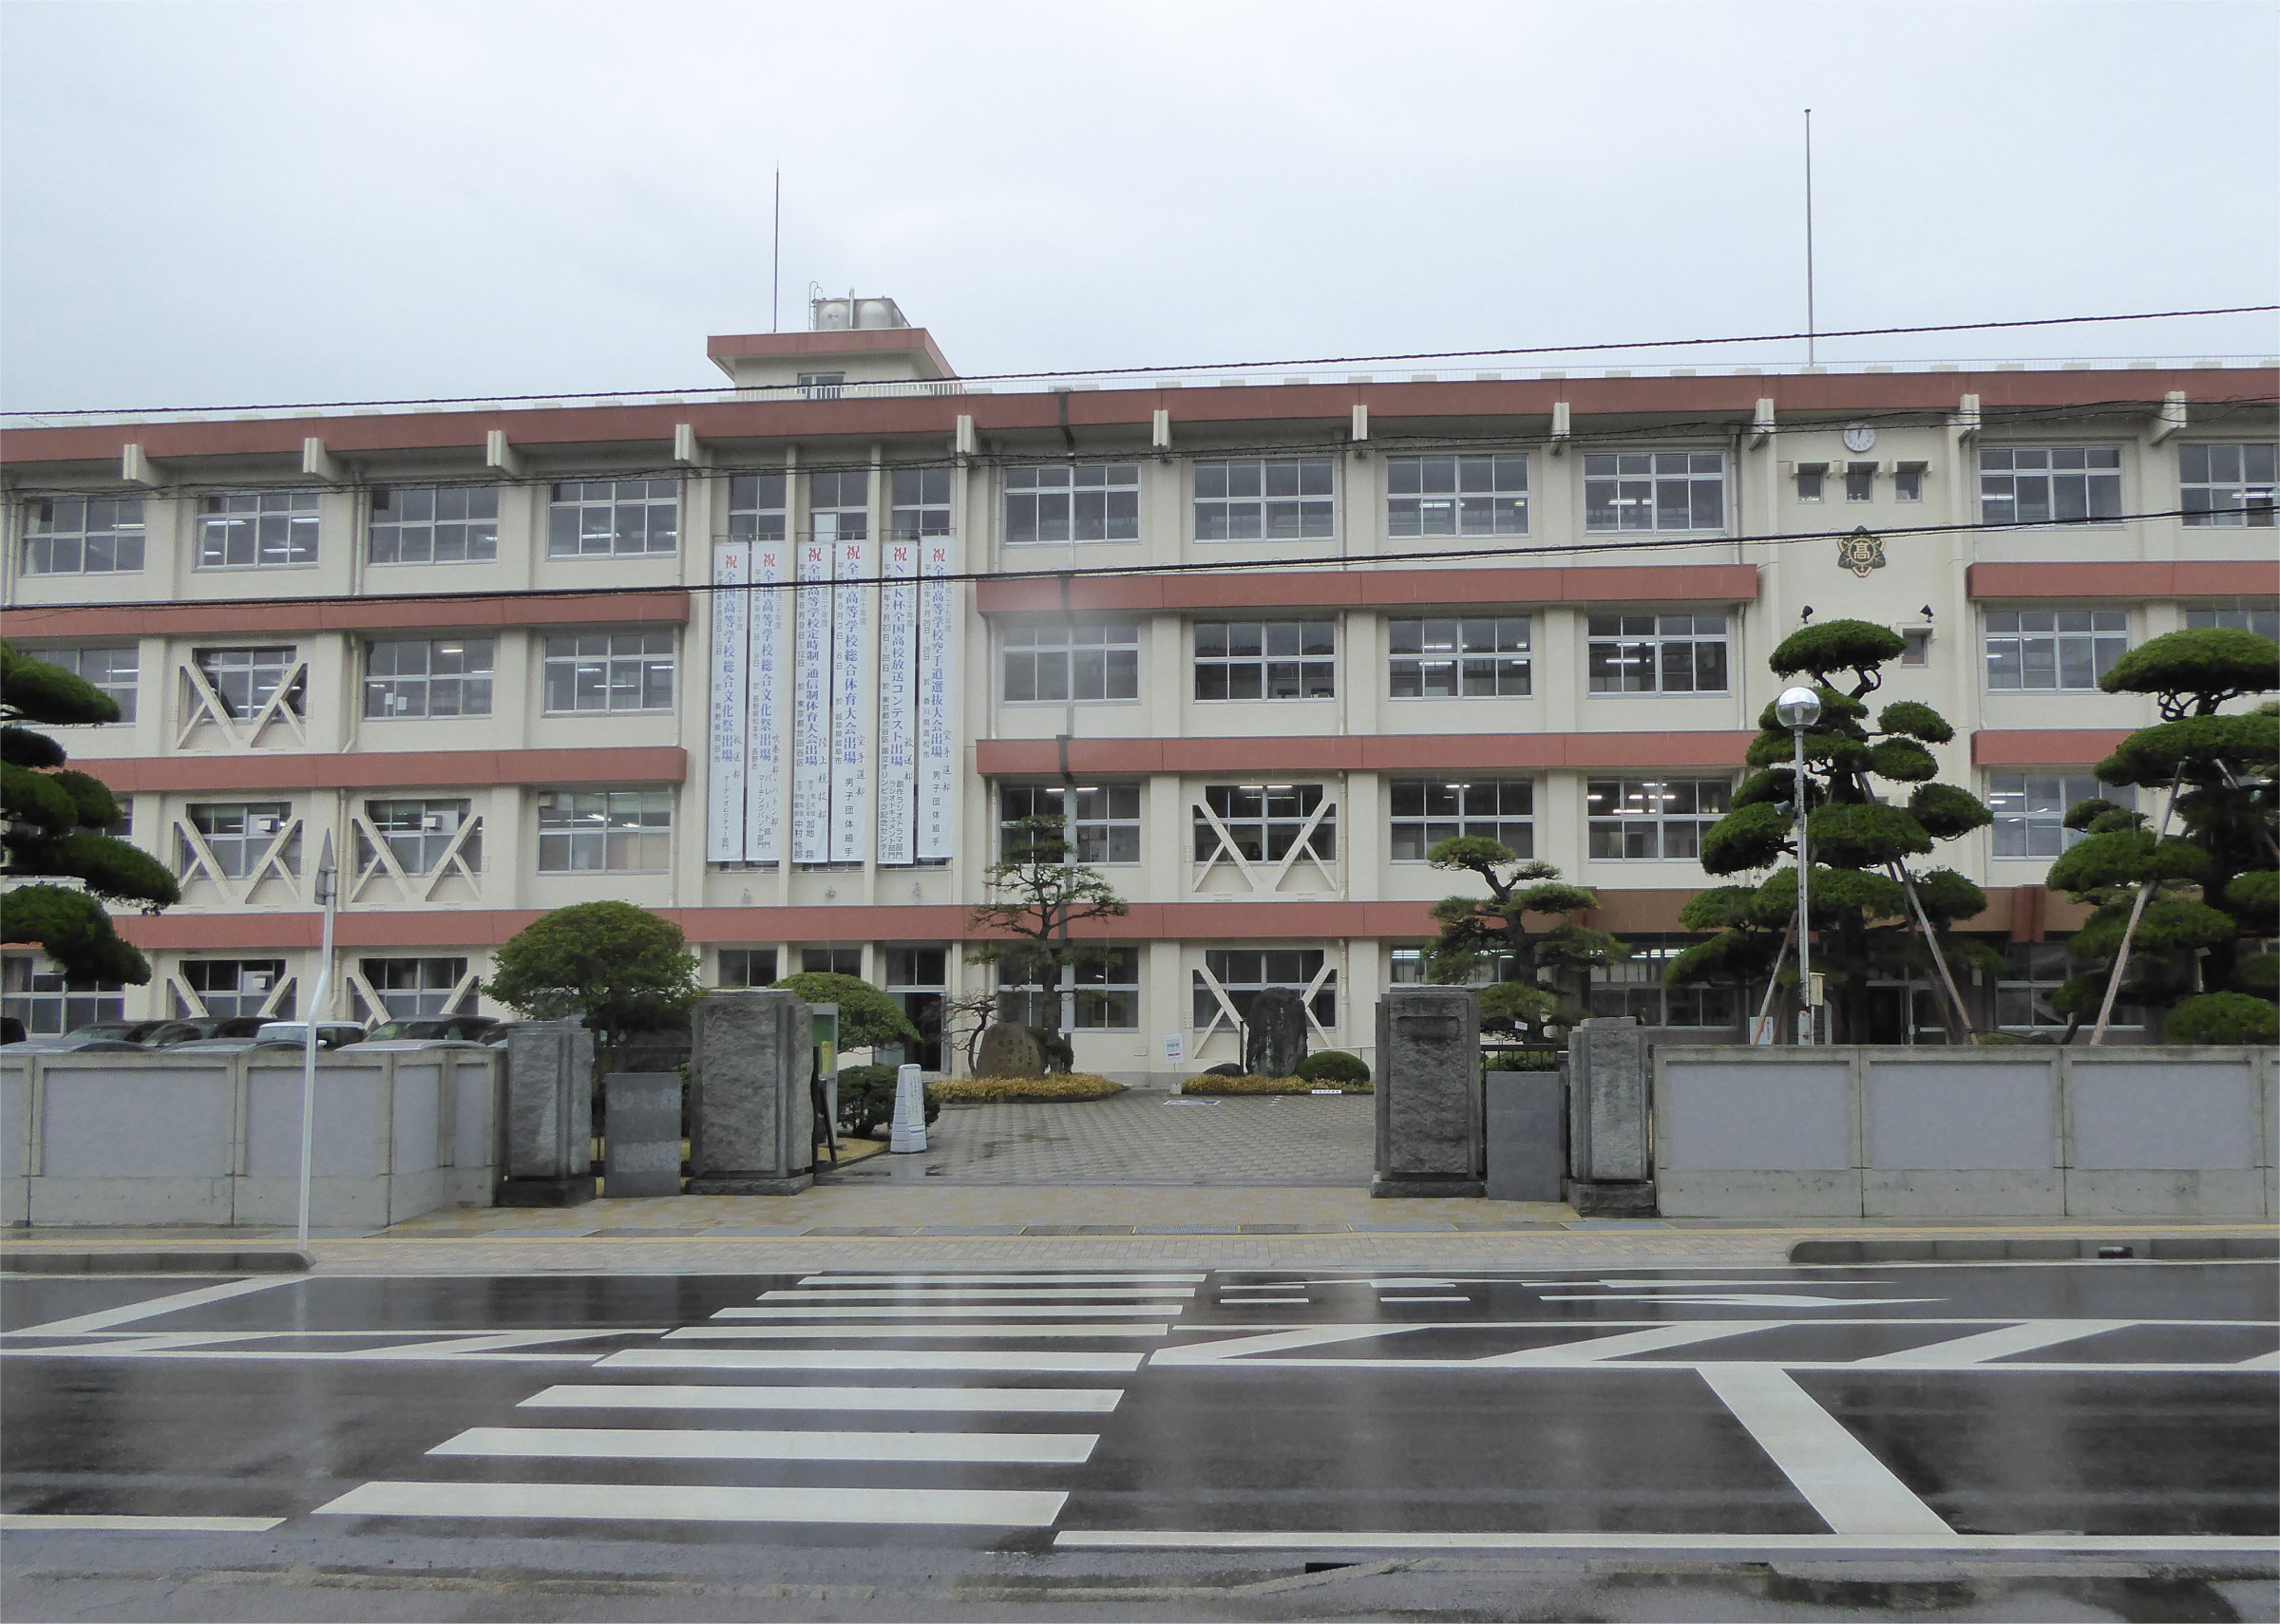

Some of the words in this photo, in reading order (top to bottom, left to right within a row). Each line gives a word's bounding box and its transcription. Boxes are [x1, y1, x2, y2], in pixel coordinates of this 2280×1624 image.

[808, 547, 822, 562] 祝
[846, 545, 861, 560] 祝
[894, 547, 906, 562] 祝
[933, 548, 945, 562] 祝
[726, 555, 737, 568] 祝
[764, 553, 775, 568] 祝
[932, 771, 940, 846] 男子団体組手
[845, 778, 854, 857] 男子団体組手
[895, 780, 904, 859] 創作ラジオドラマ部門
